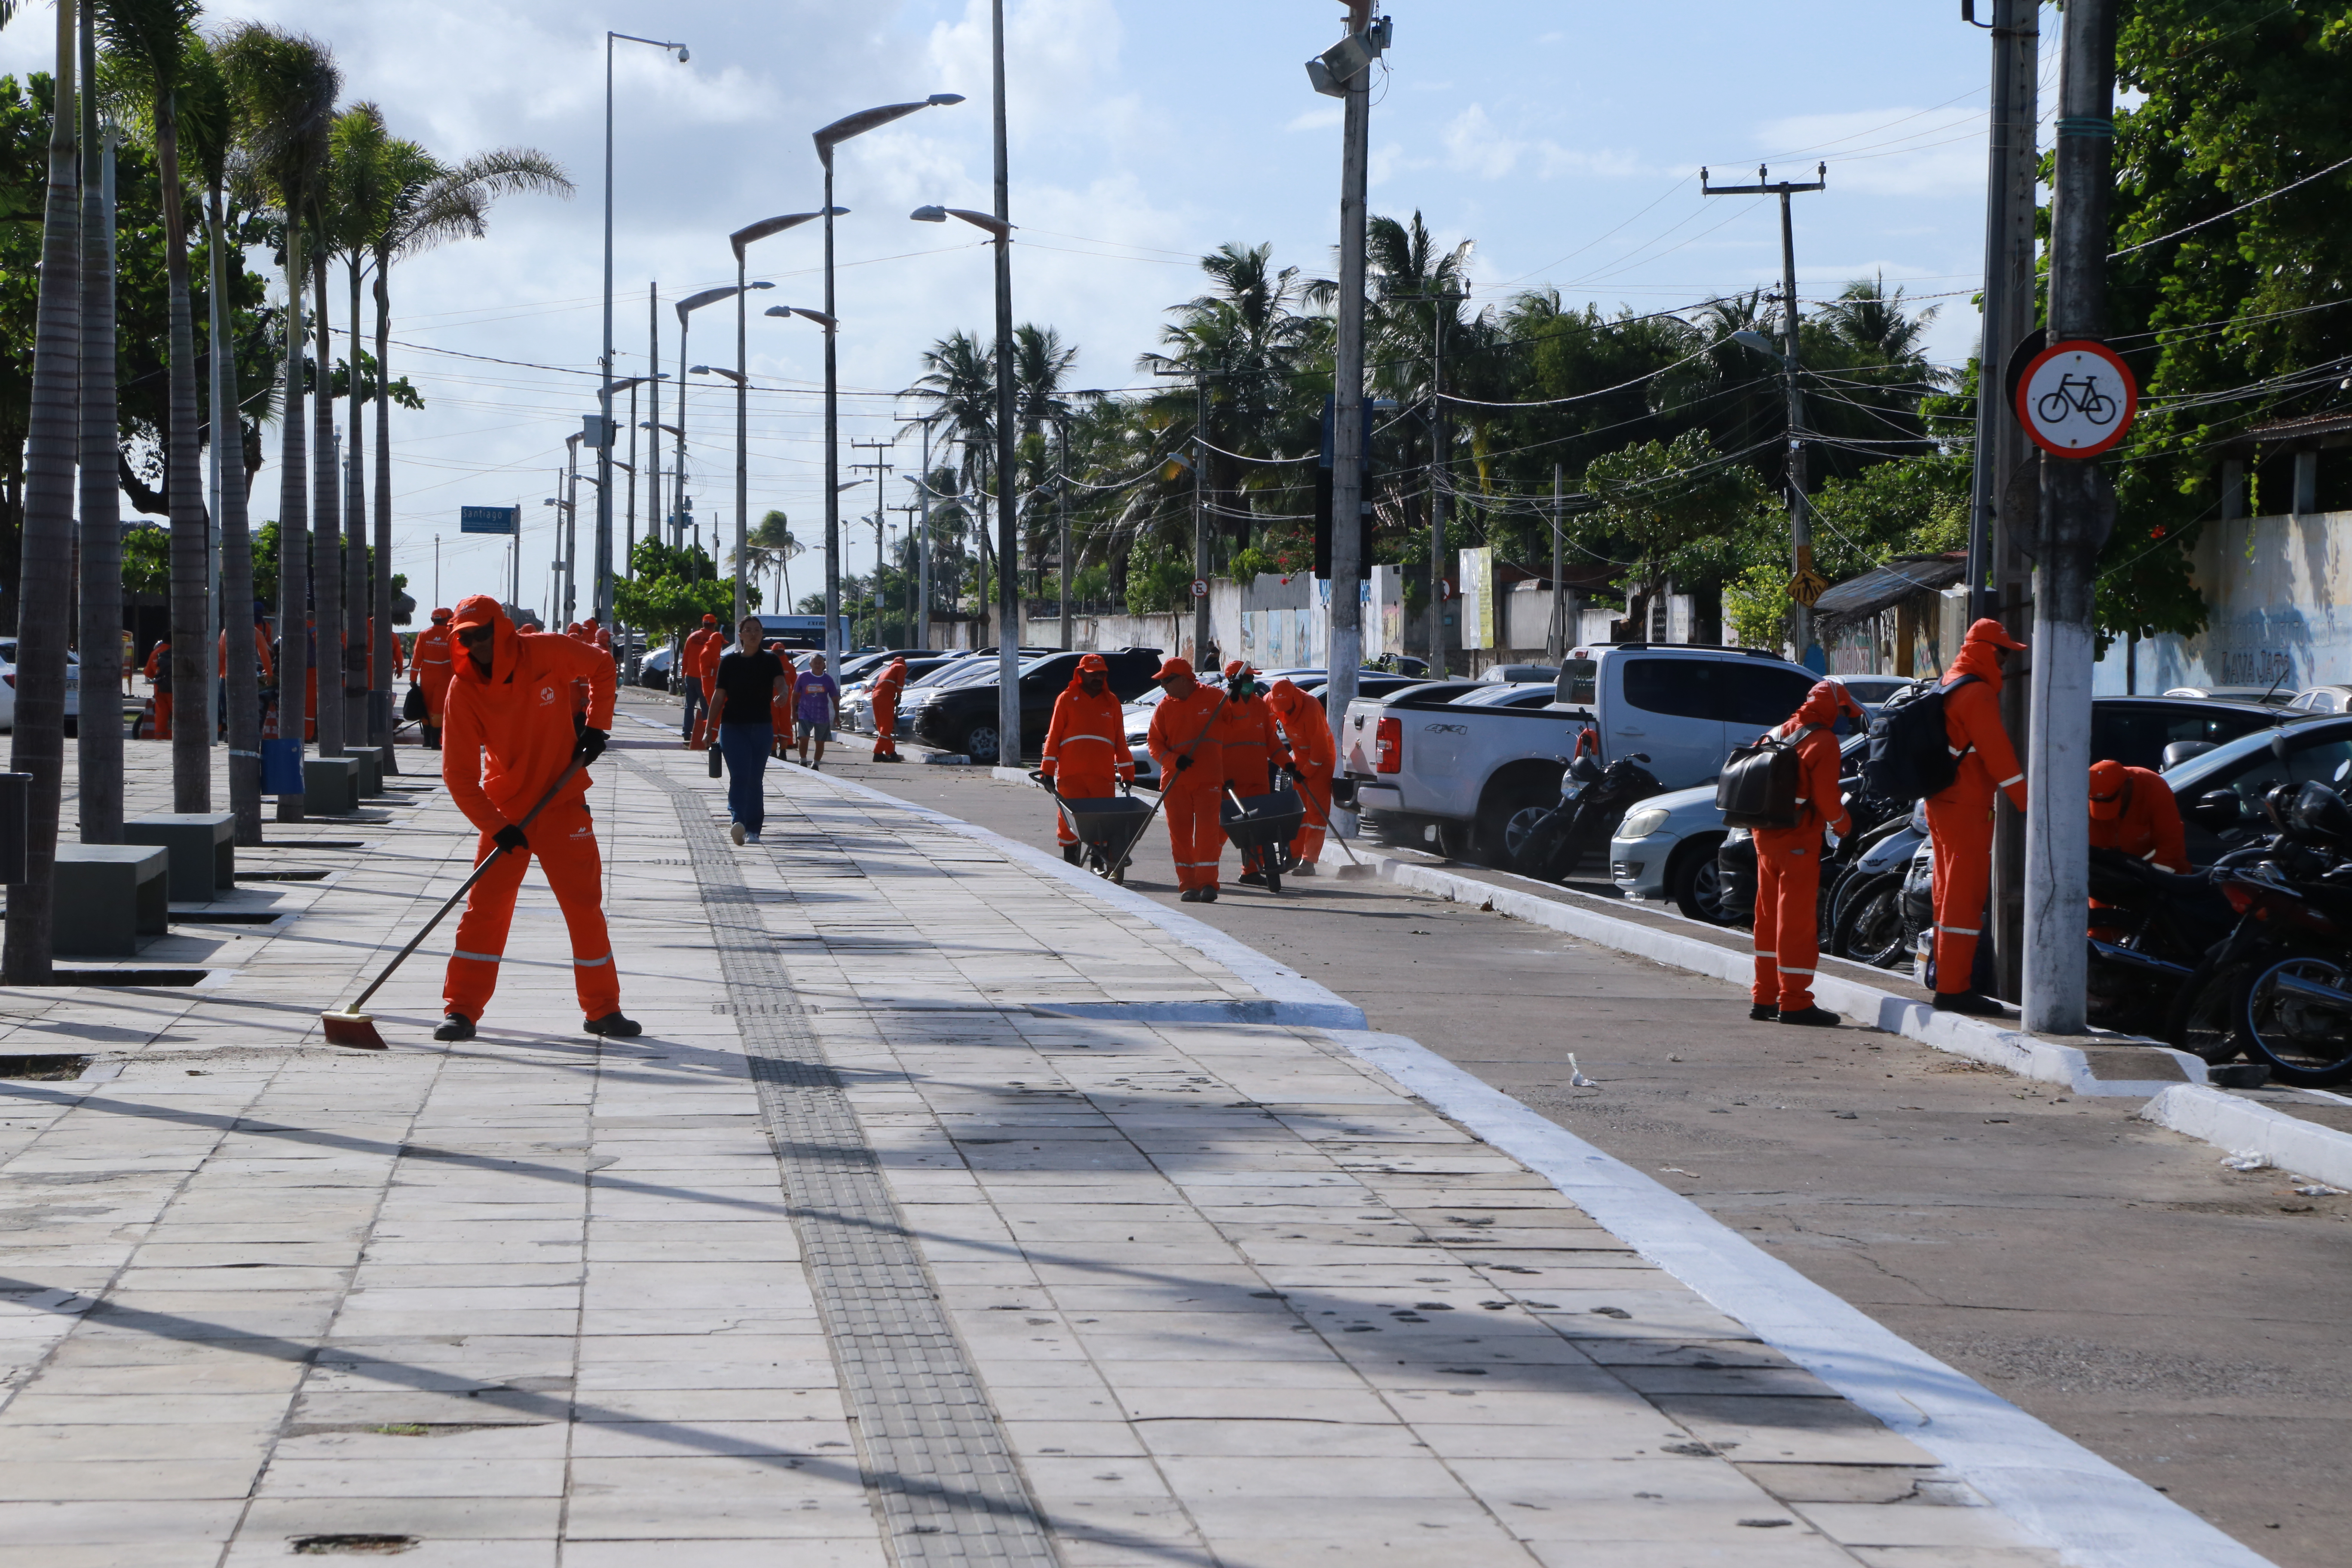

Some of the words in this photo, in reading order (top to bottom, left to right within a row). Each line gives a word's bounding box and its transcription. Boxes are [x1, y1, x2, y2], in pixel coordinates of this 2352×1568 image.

[463, 509, 502, 521] Santiago
[1196, 583, 1203, 593] E
[2220, 651, 2255, 684] LAVA
